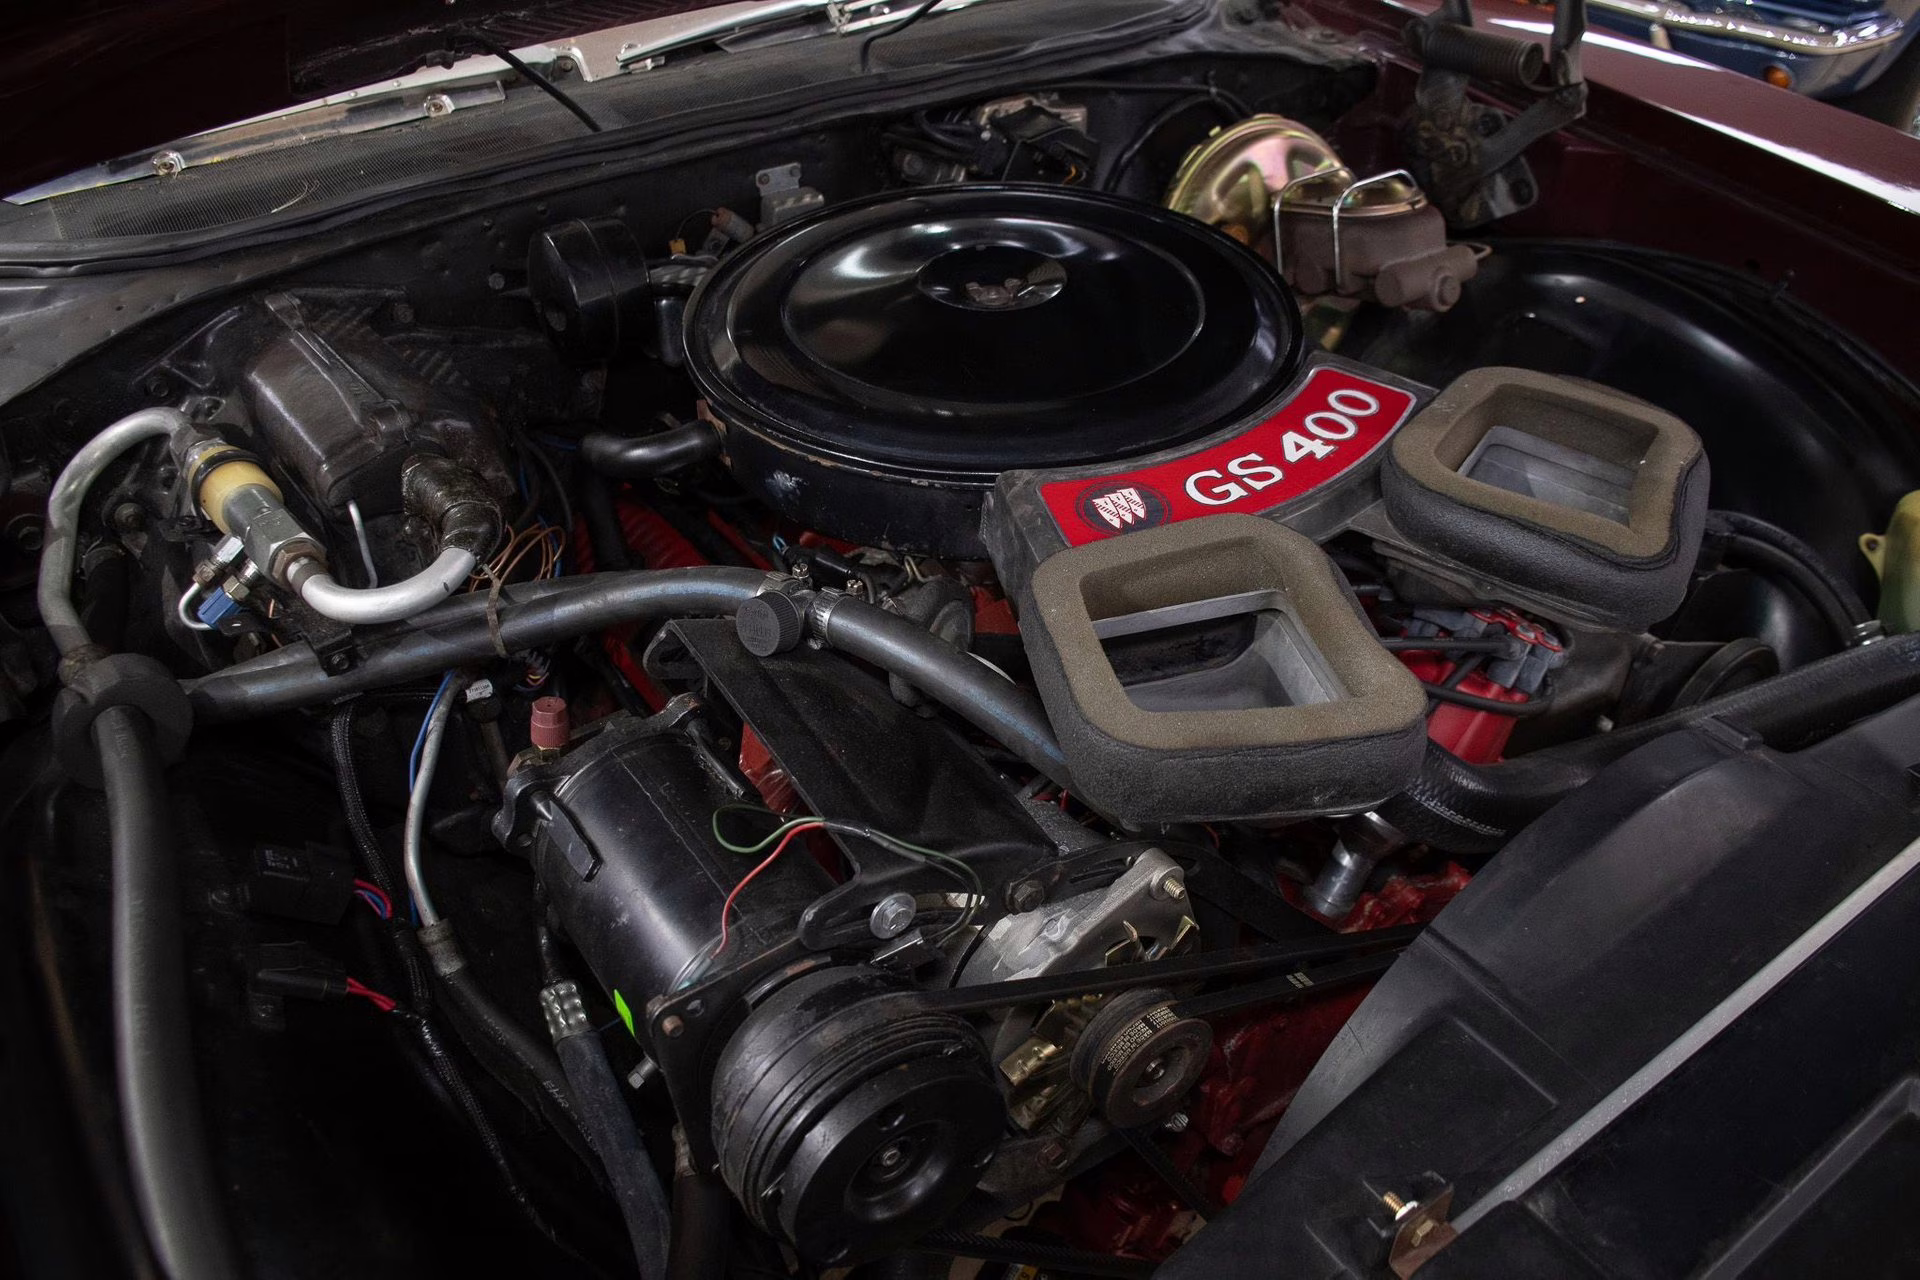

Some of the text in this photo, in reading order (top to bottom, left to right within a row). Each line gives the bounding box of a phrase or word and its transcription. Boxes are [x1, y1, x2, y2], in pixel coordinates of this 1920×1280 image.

[1185, 389, 1379, 506] GS 400
[1128, 1021, 1145, 1036] MADE
[1129, 1024, 1148, 1043] HECHO
[1135, 1028, 1152, 1043] MADE
